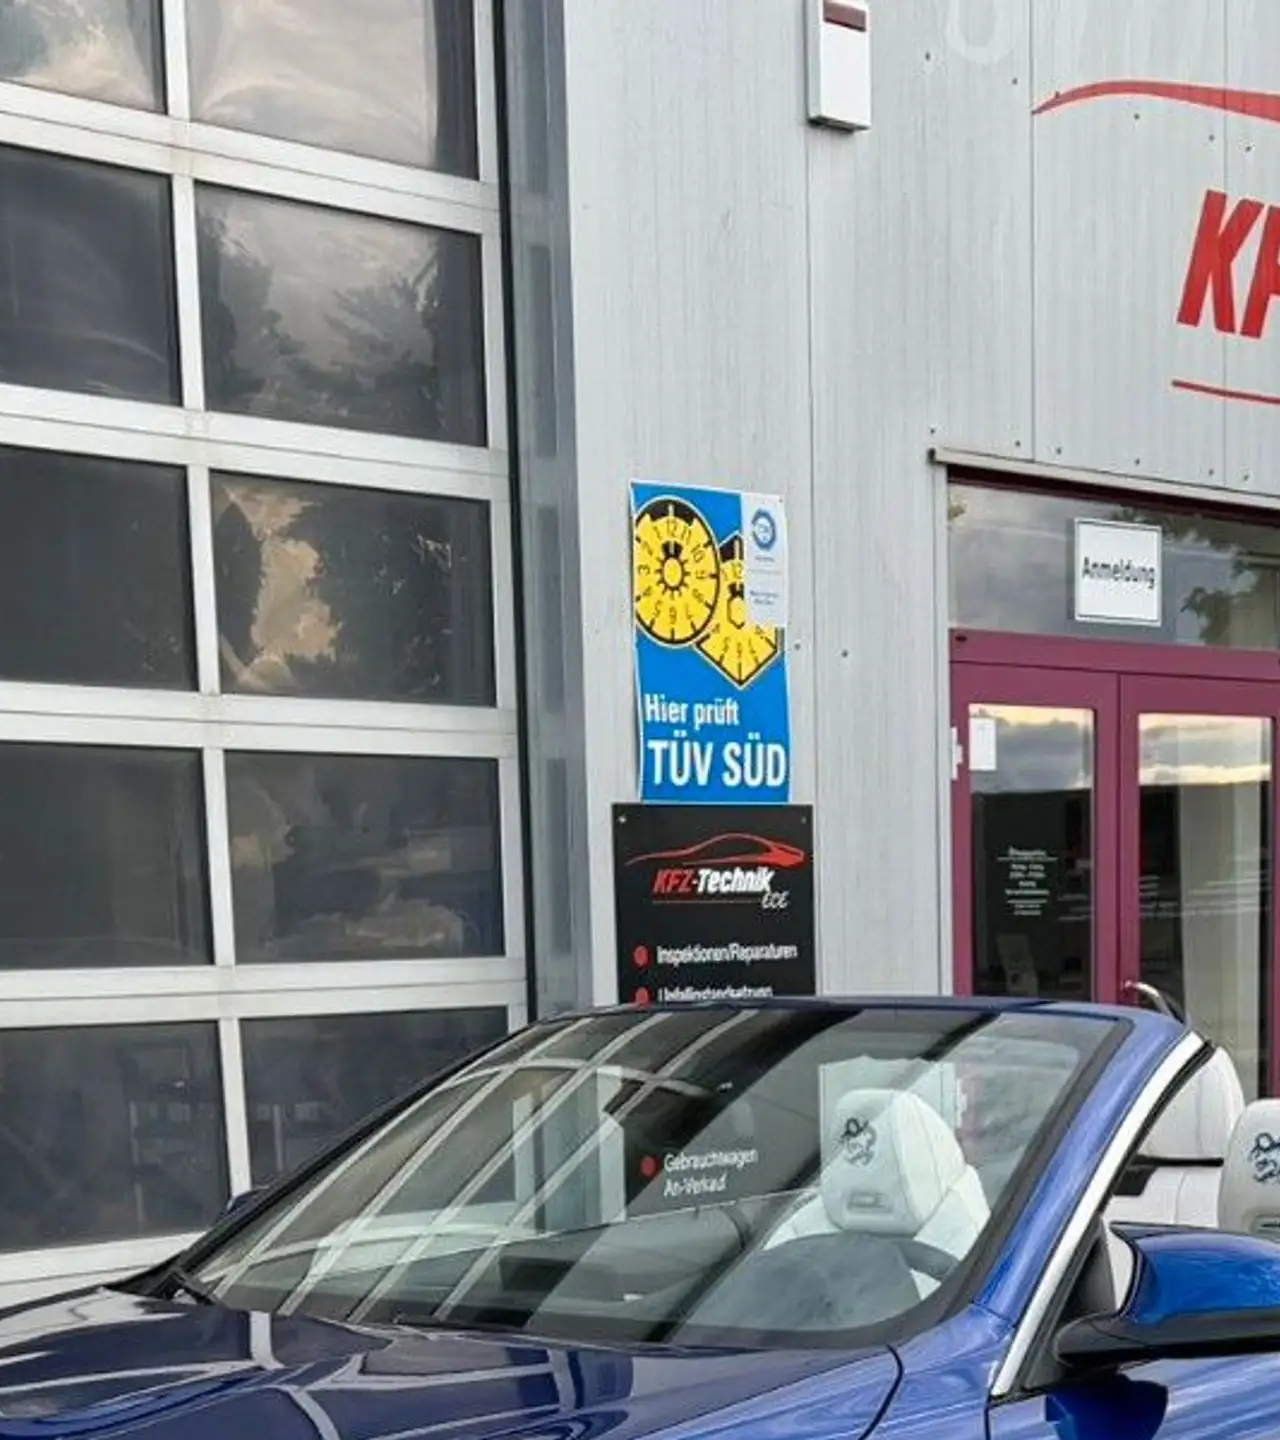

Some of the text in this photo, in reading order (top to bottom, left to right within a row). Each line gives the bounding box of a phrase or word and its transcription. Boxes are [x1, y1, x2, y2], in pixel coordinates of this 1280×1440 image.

[1082, 556, 1155, 589] Anmeldung
[644, 693, 740, 731] Hier prüft
[647, 729, 787, 788] TÜV SÜD
[652, 866, 776, 894] KFZ-Technik
